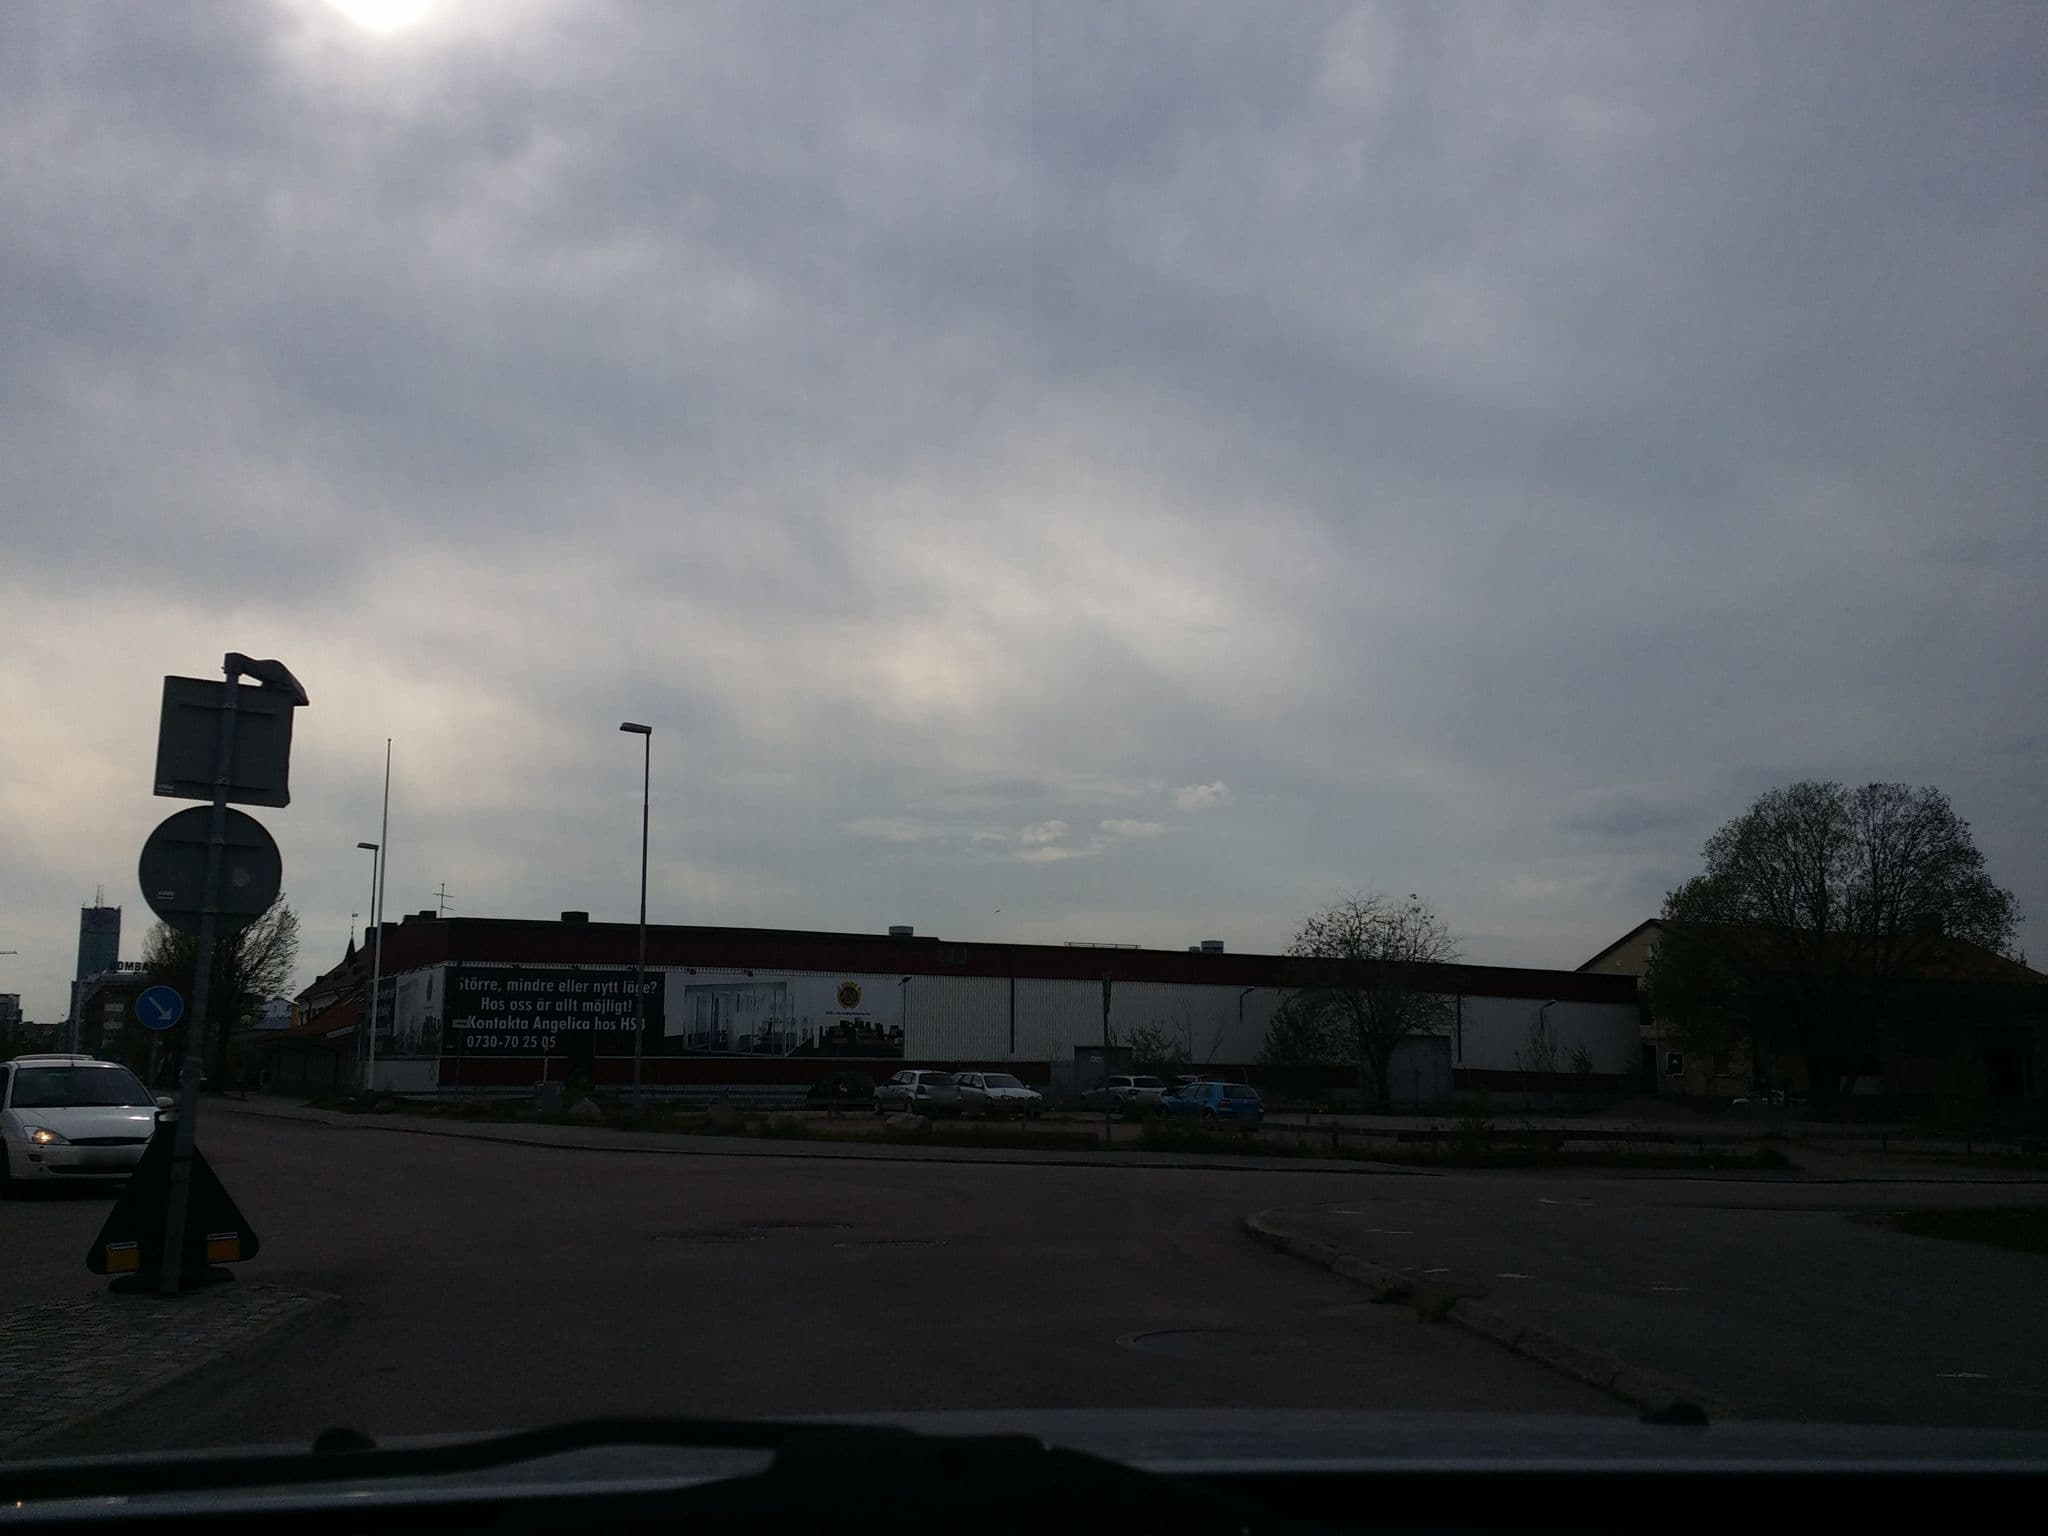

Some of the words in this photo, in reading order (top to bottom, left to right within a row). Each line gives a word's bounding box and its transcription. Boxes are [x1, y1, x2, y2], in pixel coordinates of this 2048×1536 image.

[507, 978, 554, 992] mindre
[558, 978, 589, 993] eller
[593, 981, 619, 996] nytt
[481, 996, 505, 1011] Hos
[509, 1000, 532, 1012] oss
[536, 997, 552, 1012] är
[555, 998, 577, 1013] allt
[582, 998, 632, 1015] möjligt!
[467, 1015, 529, 1030] Kontakta
[532, 1015, 590, 1033] Angelica
[594, 1015, 616, 1031] hos
[466, 1035, 519, 1048] 0730-70
[522, 1035, 538, 1048] 25
